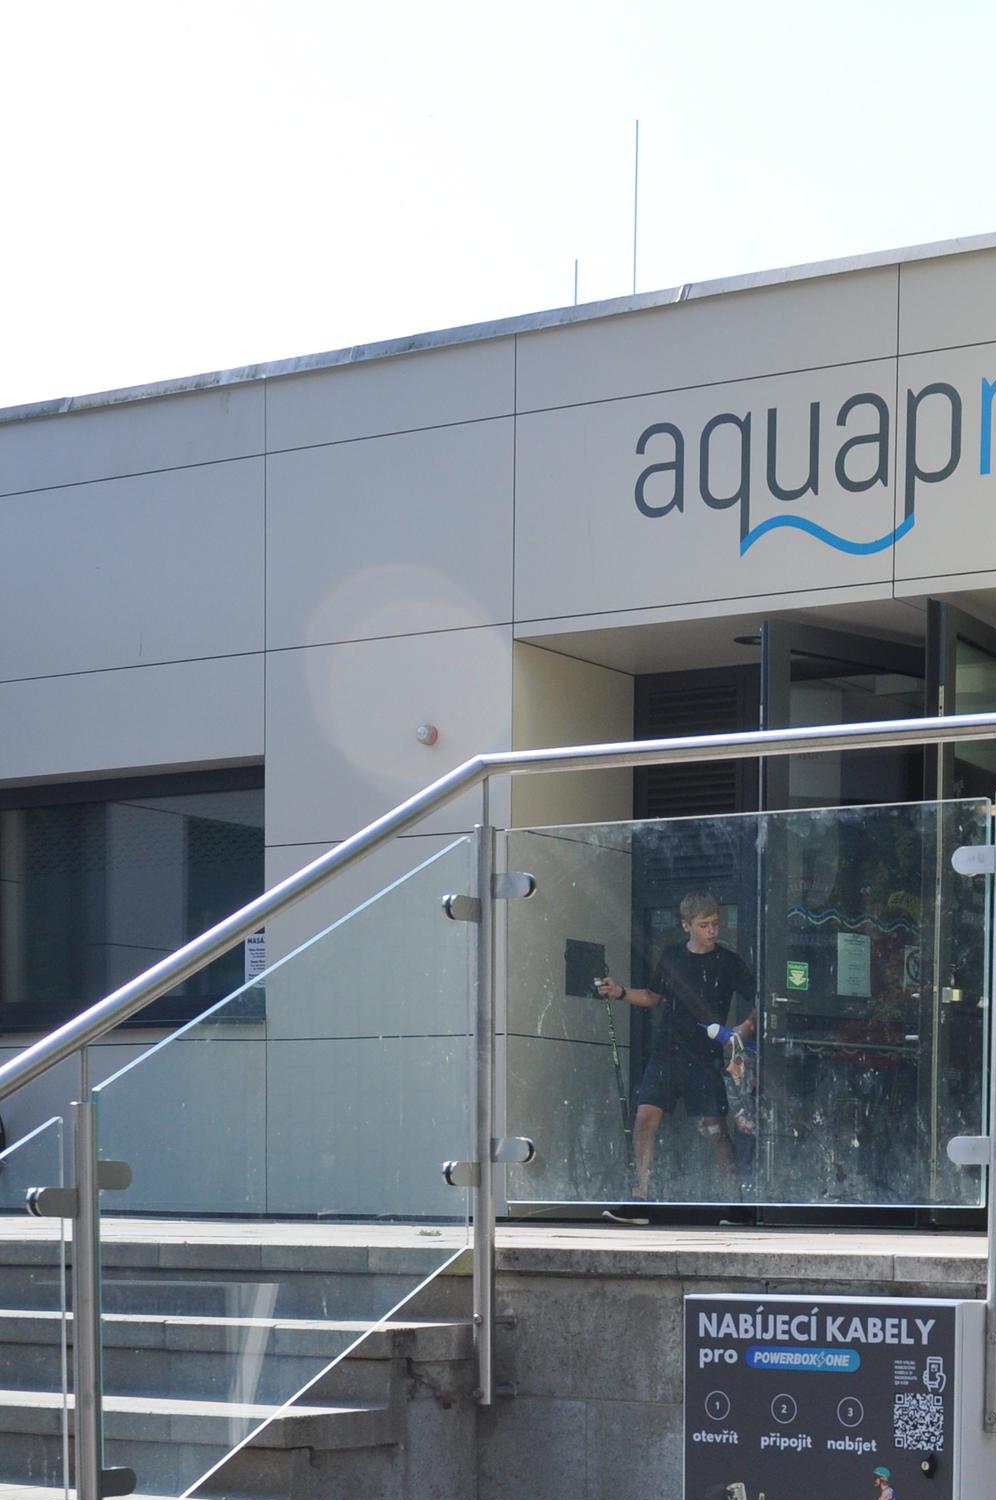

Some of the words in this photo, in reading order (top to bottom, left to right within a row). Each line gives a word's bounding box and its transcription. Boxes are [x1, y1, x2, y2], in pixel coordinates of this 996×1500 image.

[699, 1305, 819, 1341] NABÍJECÍ
[826, 1316, 936, 1345] KABELY
[699, 1347, 738, 1368] pro
[753, 1351, 817, 1367] POWERBOX
[825, 1355, 850, 1367] ONE
[715, 1401, 720, 1410] 1
[781, 1405, 788, 1414] 2
[847, 1407, 854, 1417] 3
[692, 1430, 739, 1444] otevřít
[760, 1433, 812, 1451] připojit
[827, 1437, 877, 1455] nabíjet
